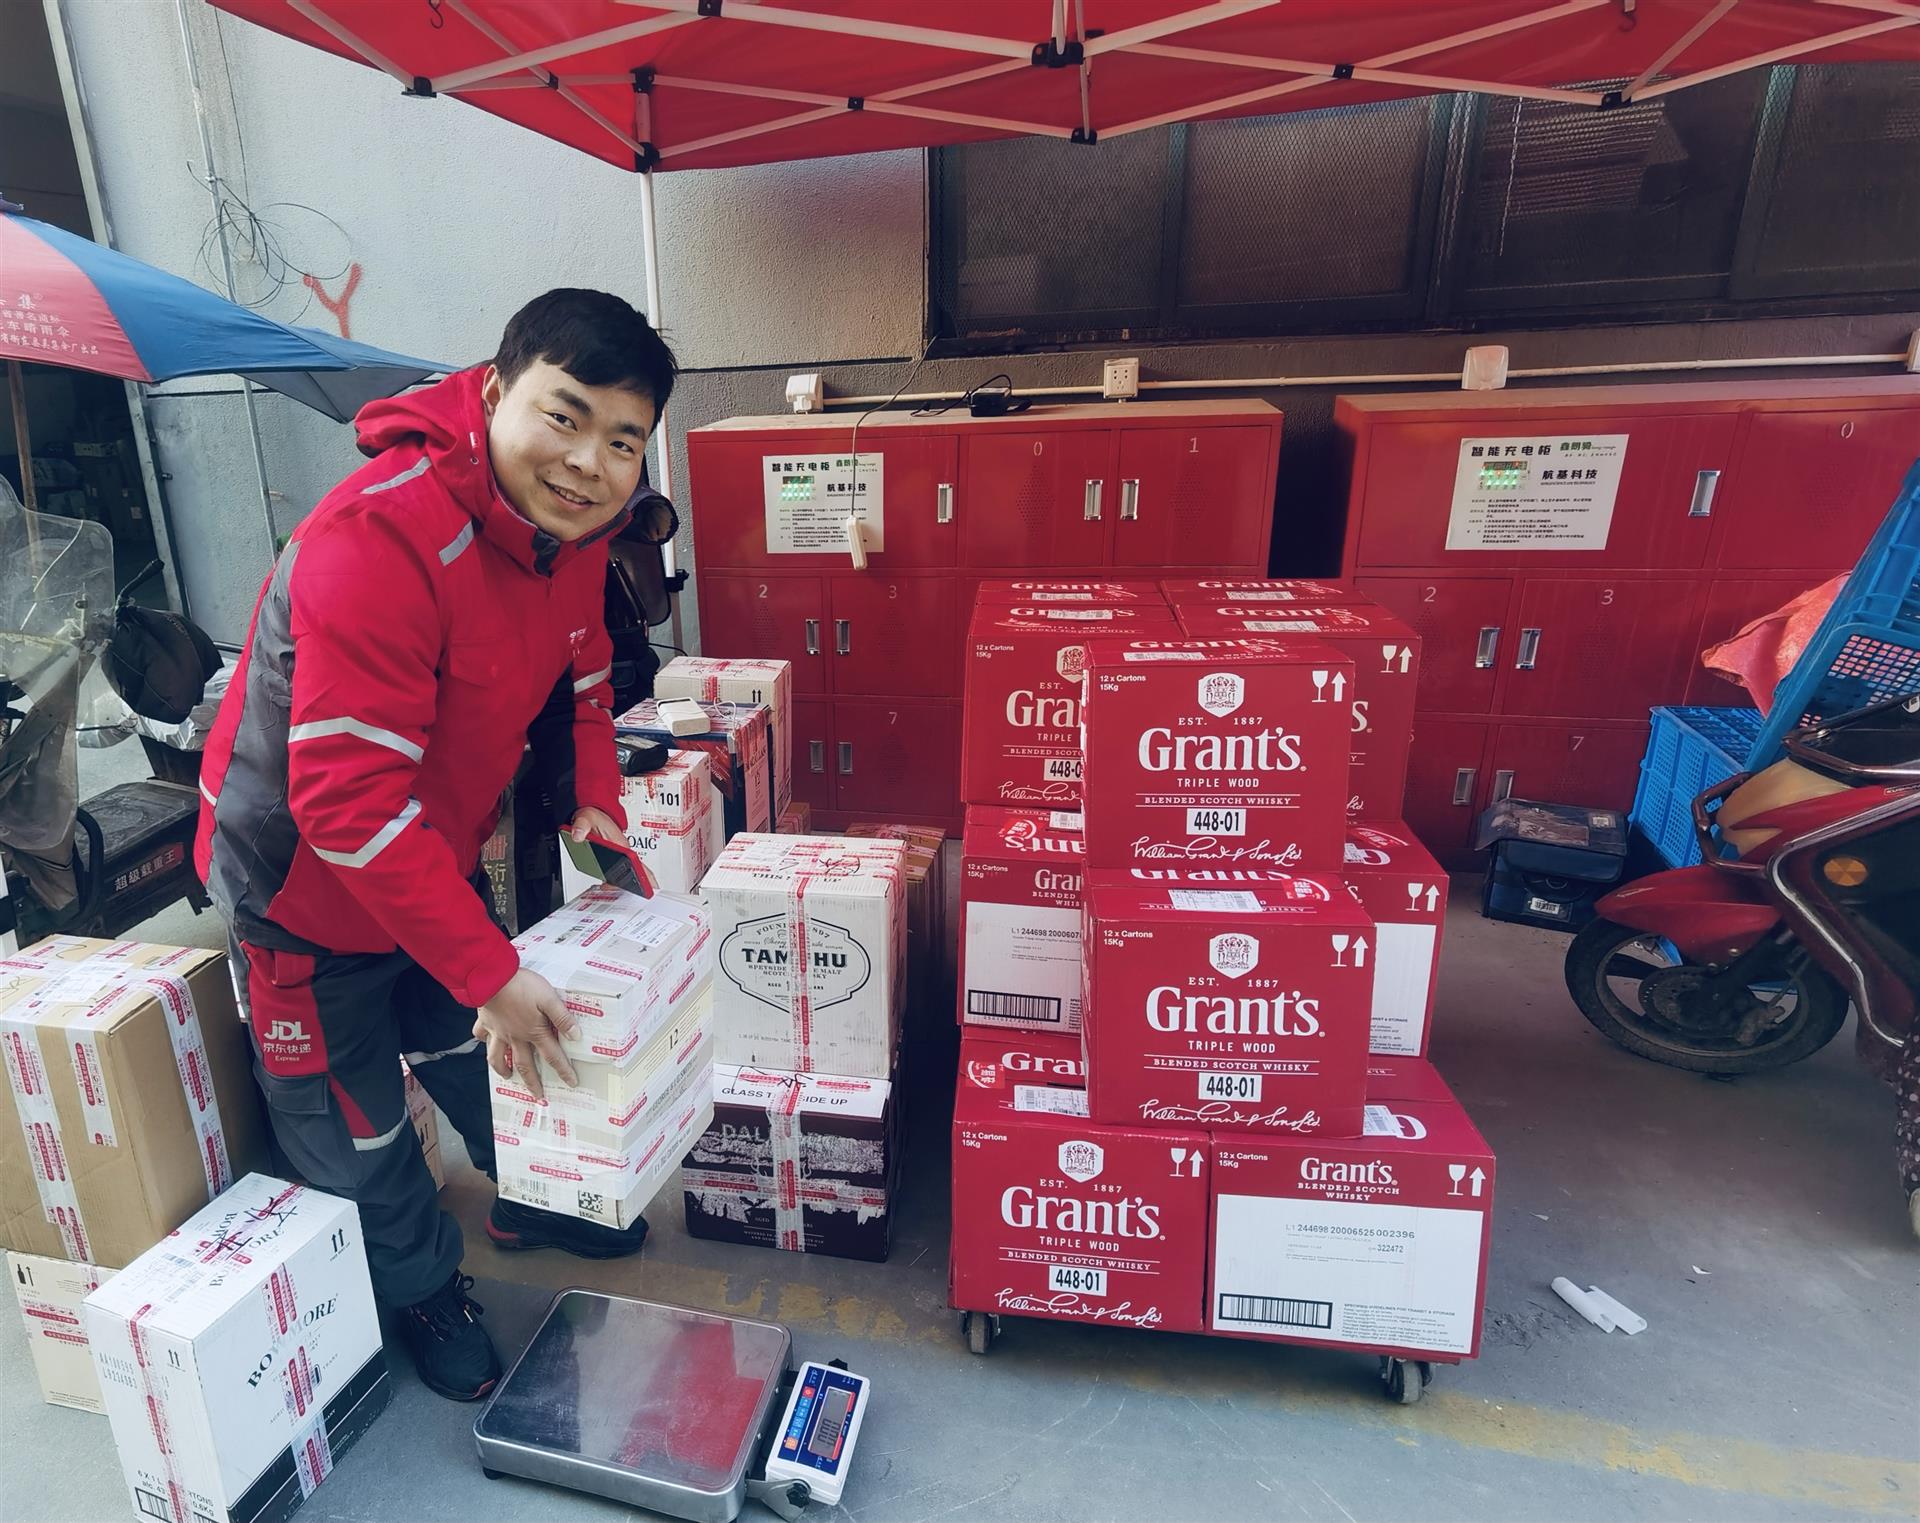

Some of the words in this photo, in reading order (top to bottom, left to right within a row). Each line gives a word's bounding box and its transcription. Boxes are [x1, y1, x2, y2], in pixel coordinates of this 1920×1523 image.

[1841, 421, 1854, 439] 0
[1033, 441, 1043, 457] 0
[1189, 437, 1199, 453] 1
[1471, 445, 1552, 457] 智能充电柜
[772, 462, 830, 473] 智能充电柜
[1542, 469, 1598, 481] 航基科技
[827, 483, 867, 492] 航基科技
[759, 584, 769, 599] 2
[888, 585, 898, 600] 3
[1424, 586, 1437, 602] 2
[1602, 589, 1614, 606] 3
[1216, 607, 1352, 617] Grant's
[1129, 638, 1280, 649] Grant's
[976, 651, 991, 659] 15Kg
[1100, 675, 1109, 683] 12
[1116, 674, 1146, 683] Cartons
[1039, 682, 1063, 690] EST.
[1100, 684, 1119, 692] 15Kg
[889, 711, 898, 725] 7
[1178, 717, 1208, 726] EST.
[1233, 717, 1263, 726] 1887
[1037, 733, 1072, 742] TRIPLE
[1138, 727, 1302, 772] Grant's
[1572, 736, 1584, 752] 7
[1010, 748, 1052, 756] BLENDED
[1177, 778, 1220, 788] TRIPLE
[1228, 778, 1260, 788] WOOD
[1145, 797, 1196, 805] BLENDED
[1200, 797, 1242, 805] SCOTCH
[1246, 797, 1291, 805] WHISKY
[1193, 810, 1240, 832] 448-01
[1131, 836, 1185, 860] William
[1185, 837, 1232, 860] Grant
[968, 871, 984, 879] 15Kg
[1032, 892, 1076, 900] BLENDED
[1021, 928, 1047, 937] 244698
[1104, 930, 1113, 938] 12
[1121, 930, 1153, 939] Cartons
[1104, 939, 1124, 947] 15Kg
[742, 948, 847, 969] TAMHU
[1188, 976, 1219, 986] EST.
[1248, 979, 1279, 988] 1887
[1146, 985, 1320, 1037] Grant's
[264, 1020, 311, 1041] JDL
[264, 1042, 311, 1054] 京东快递
[1188, 1040, 1233, 1052] TRIPLE
[1243, 1042, 1276, 1054] WOOD
[1153, 1058, 1208, 1069] BLENDED
[1212, 1061, 1258, 1071] SCOTCH
[1263, 1062, 1310, 1072] WHISKY
[1206, 1076, 1255, 1098] 448-01
[722, 1088, 764, 1099] GLASS
[1139, 1099, 1197, 1122] William
[1197, 1102, 1246, 1123] Grant
[978, 1132, 1007, 1141] Cartons
[962, 1139, 981, 1148] 15Kg
[1236, 1153, 1268, 1161] Cartons
[1219, 1160, 1239, 1169] 15Kg
[1300, 1157, 1393, 1185] Grant's
[1040, 1178, 1068, 1189] EST.
[1094, 1184, 1122, 1193] 1887
[1297, 1182, 1350, 1192] BLENDED
[1356, 1185, 1400, 1195] SCOTCH
[1326, 1191, 1371, 1202] WHISKY
[1001, 1185, 1160, 1240] Grant's
[1297, 1224, 1329, 1234] 244698
[1330, 1226, 1375, 1236] 20006525
[1376, 1229, 1415, 1239] 002396
[1040, 1236, 1081, 1248] TRIPLE
[1089, 1241, 1120, 1252] WOOD
[1377, 1244, 1404, 1253] 322472
[1008, 1251, 1057, 1262] BLENDED
[1062, 1256, 1103, 1266] SCOTCH
[1108, 1260, 1151, 1271] WHISKY
[1055, 1269, 1100, 1291] 448-01
[994, 1288, 1049, 1313] William
[1049, 1293, 1093, 1316] Grant
